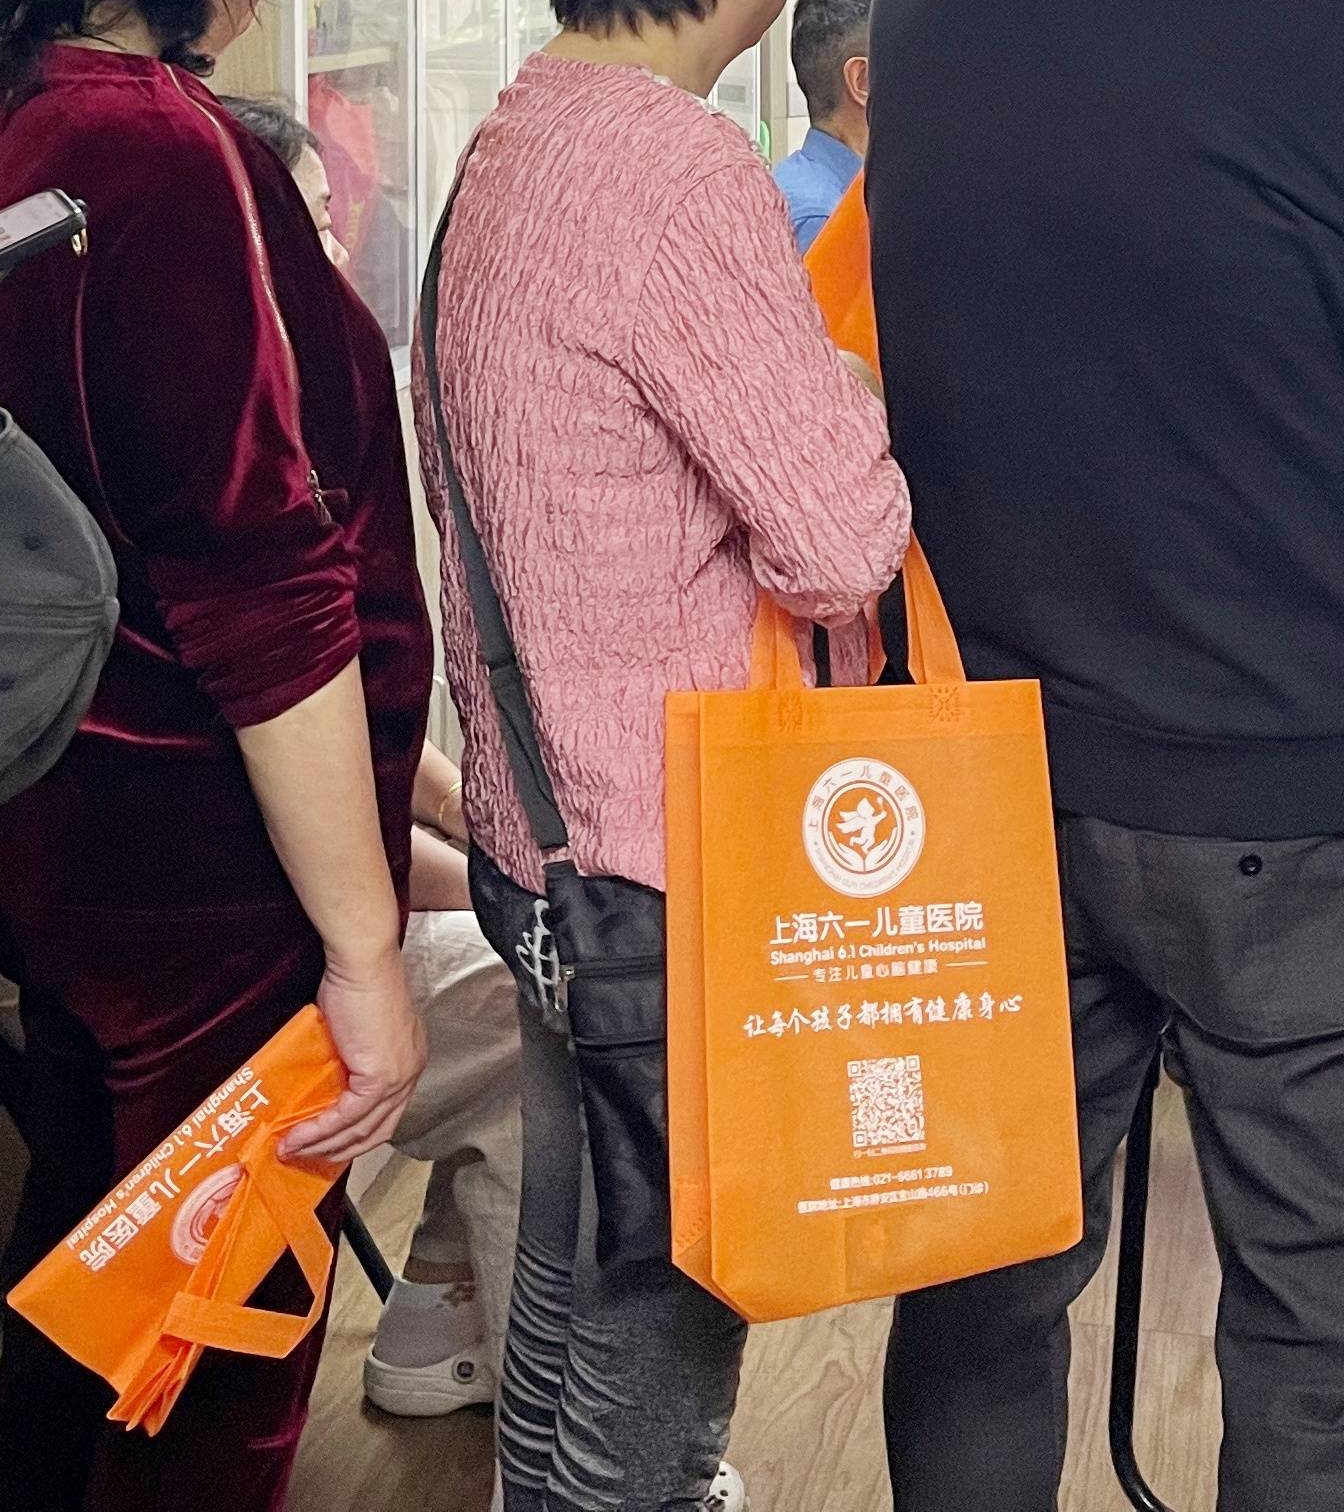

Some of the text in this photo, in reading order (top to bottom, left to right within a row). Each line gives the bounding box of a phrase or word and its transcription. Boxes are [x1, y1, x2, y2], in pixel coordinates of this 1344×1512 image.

[769, 901, 984, 945] 上海六一儿童医院
[770, 936, 986, 966] Shanghai 6.1 Children's Hospital
[743, 991, 1024, 1038] 让每个孩子都拥有健康身心
[191, 1066, 254, 1129] Shanghai
[79, 1079, 270, 1272] 上海六一儿童医院
[115, 1142, 175, 1200] Children's
[66, 1198, 118, 1251] Hospital
